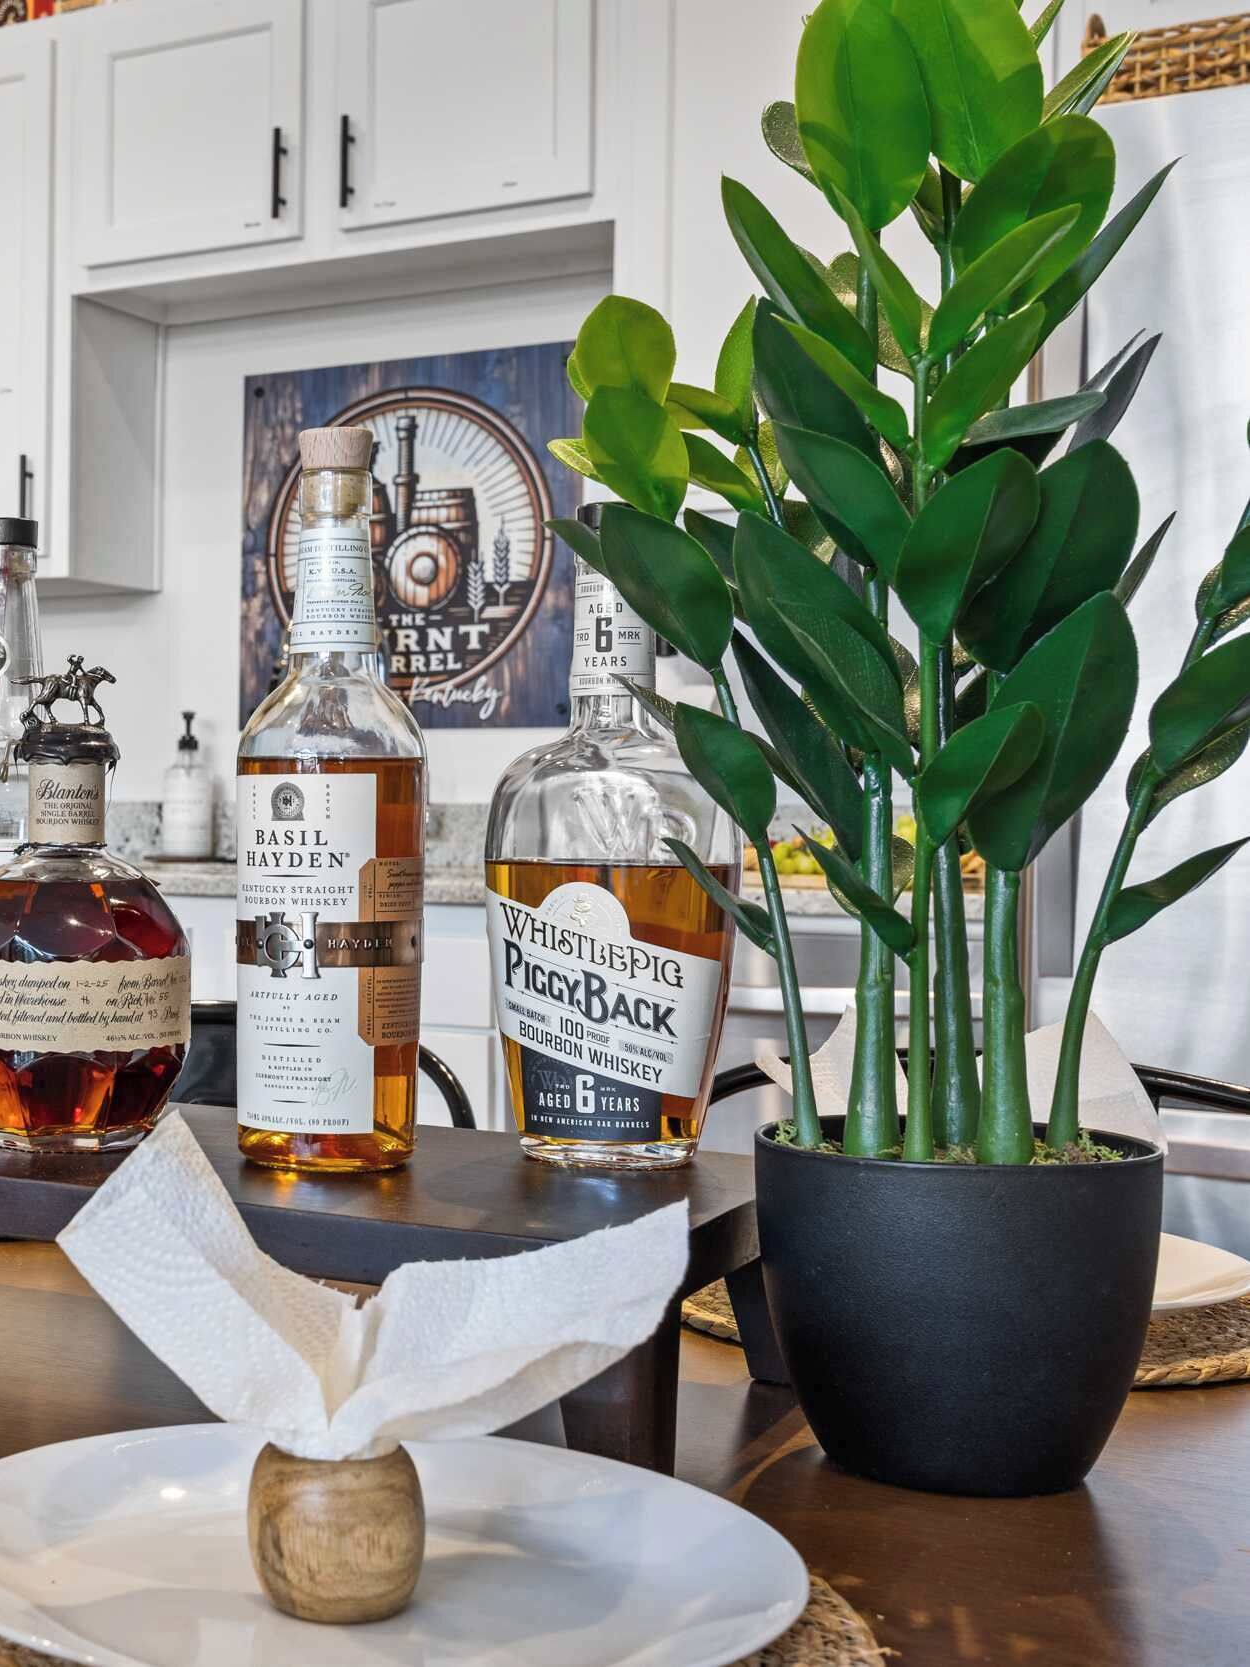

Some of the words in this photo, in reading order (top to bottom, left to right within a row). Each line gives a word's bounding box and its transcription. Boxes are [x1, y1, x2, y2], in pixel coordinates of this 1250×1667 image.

[588, 603, 623, 614] AGED
[389, 613, 426, 627] THE
[383, 624, 490, 652] RNT
[596, 616, 612, 652] 6
[618, 631, 640, 640] MRK
[584, 656, 627, 667] YEARS
[409, 674, 503, 720] Kentucky
[36, 779, 98, 800] Blanton's
[256, 829, 328, 846] BASIL
[242, 884, 286, 894] KENTUCKY
[291, 886, 354, 894] STRAIGHT
[245, 896, 286, 905] BOURBON
[292, 897, 348, 906] WHISKEY
[18, 974, 59, 991] dumped
[59, 980, 70, 990] on
[118, 976, 138, 992] from
[6, 994, 14, 1004] in
[14, 992, 66, 1006] Warehouse
[106, 997, 118, 1006] on
[118, 992, 142, 1008] Rick
[250, 990, 300, 1000] ARTFULLY
[12, 1010, 46, 1026] filtered
[46, 1012, 66, 1024] and
[66, 1012, 98, 1024] bottled
[98, 1012, 110, 1028] by
[110, 1011, 134, 1024] hand
[134, 1012, 144, 1024] at
[508, 1001, 525, 1016] SMALL
[526, 1006, 546, 1022] BATCH
[22, 1032, 58, 1041] WHISKEY
[560, 1016, 584, 1040] 100
[586, 1030, 610, 1044] PROOF
[520, 1020, 582, 1060] BOURBON
[588, 1047, 662, 1084] WHISKEY
[624, 1044, 638, 1055] 50%
[262, 1054, 321, 1063] DISTILLED
[539, 1092, 570, 1108] AGED
[576, 1074, 595, 1114] 6
[601, 1096, 640, 1112] YEARS
[557, 1118, 592, 1126] AMERICAN
